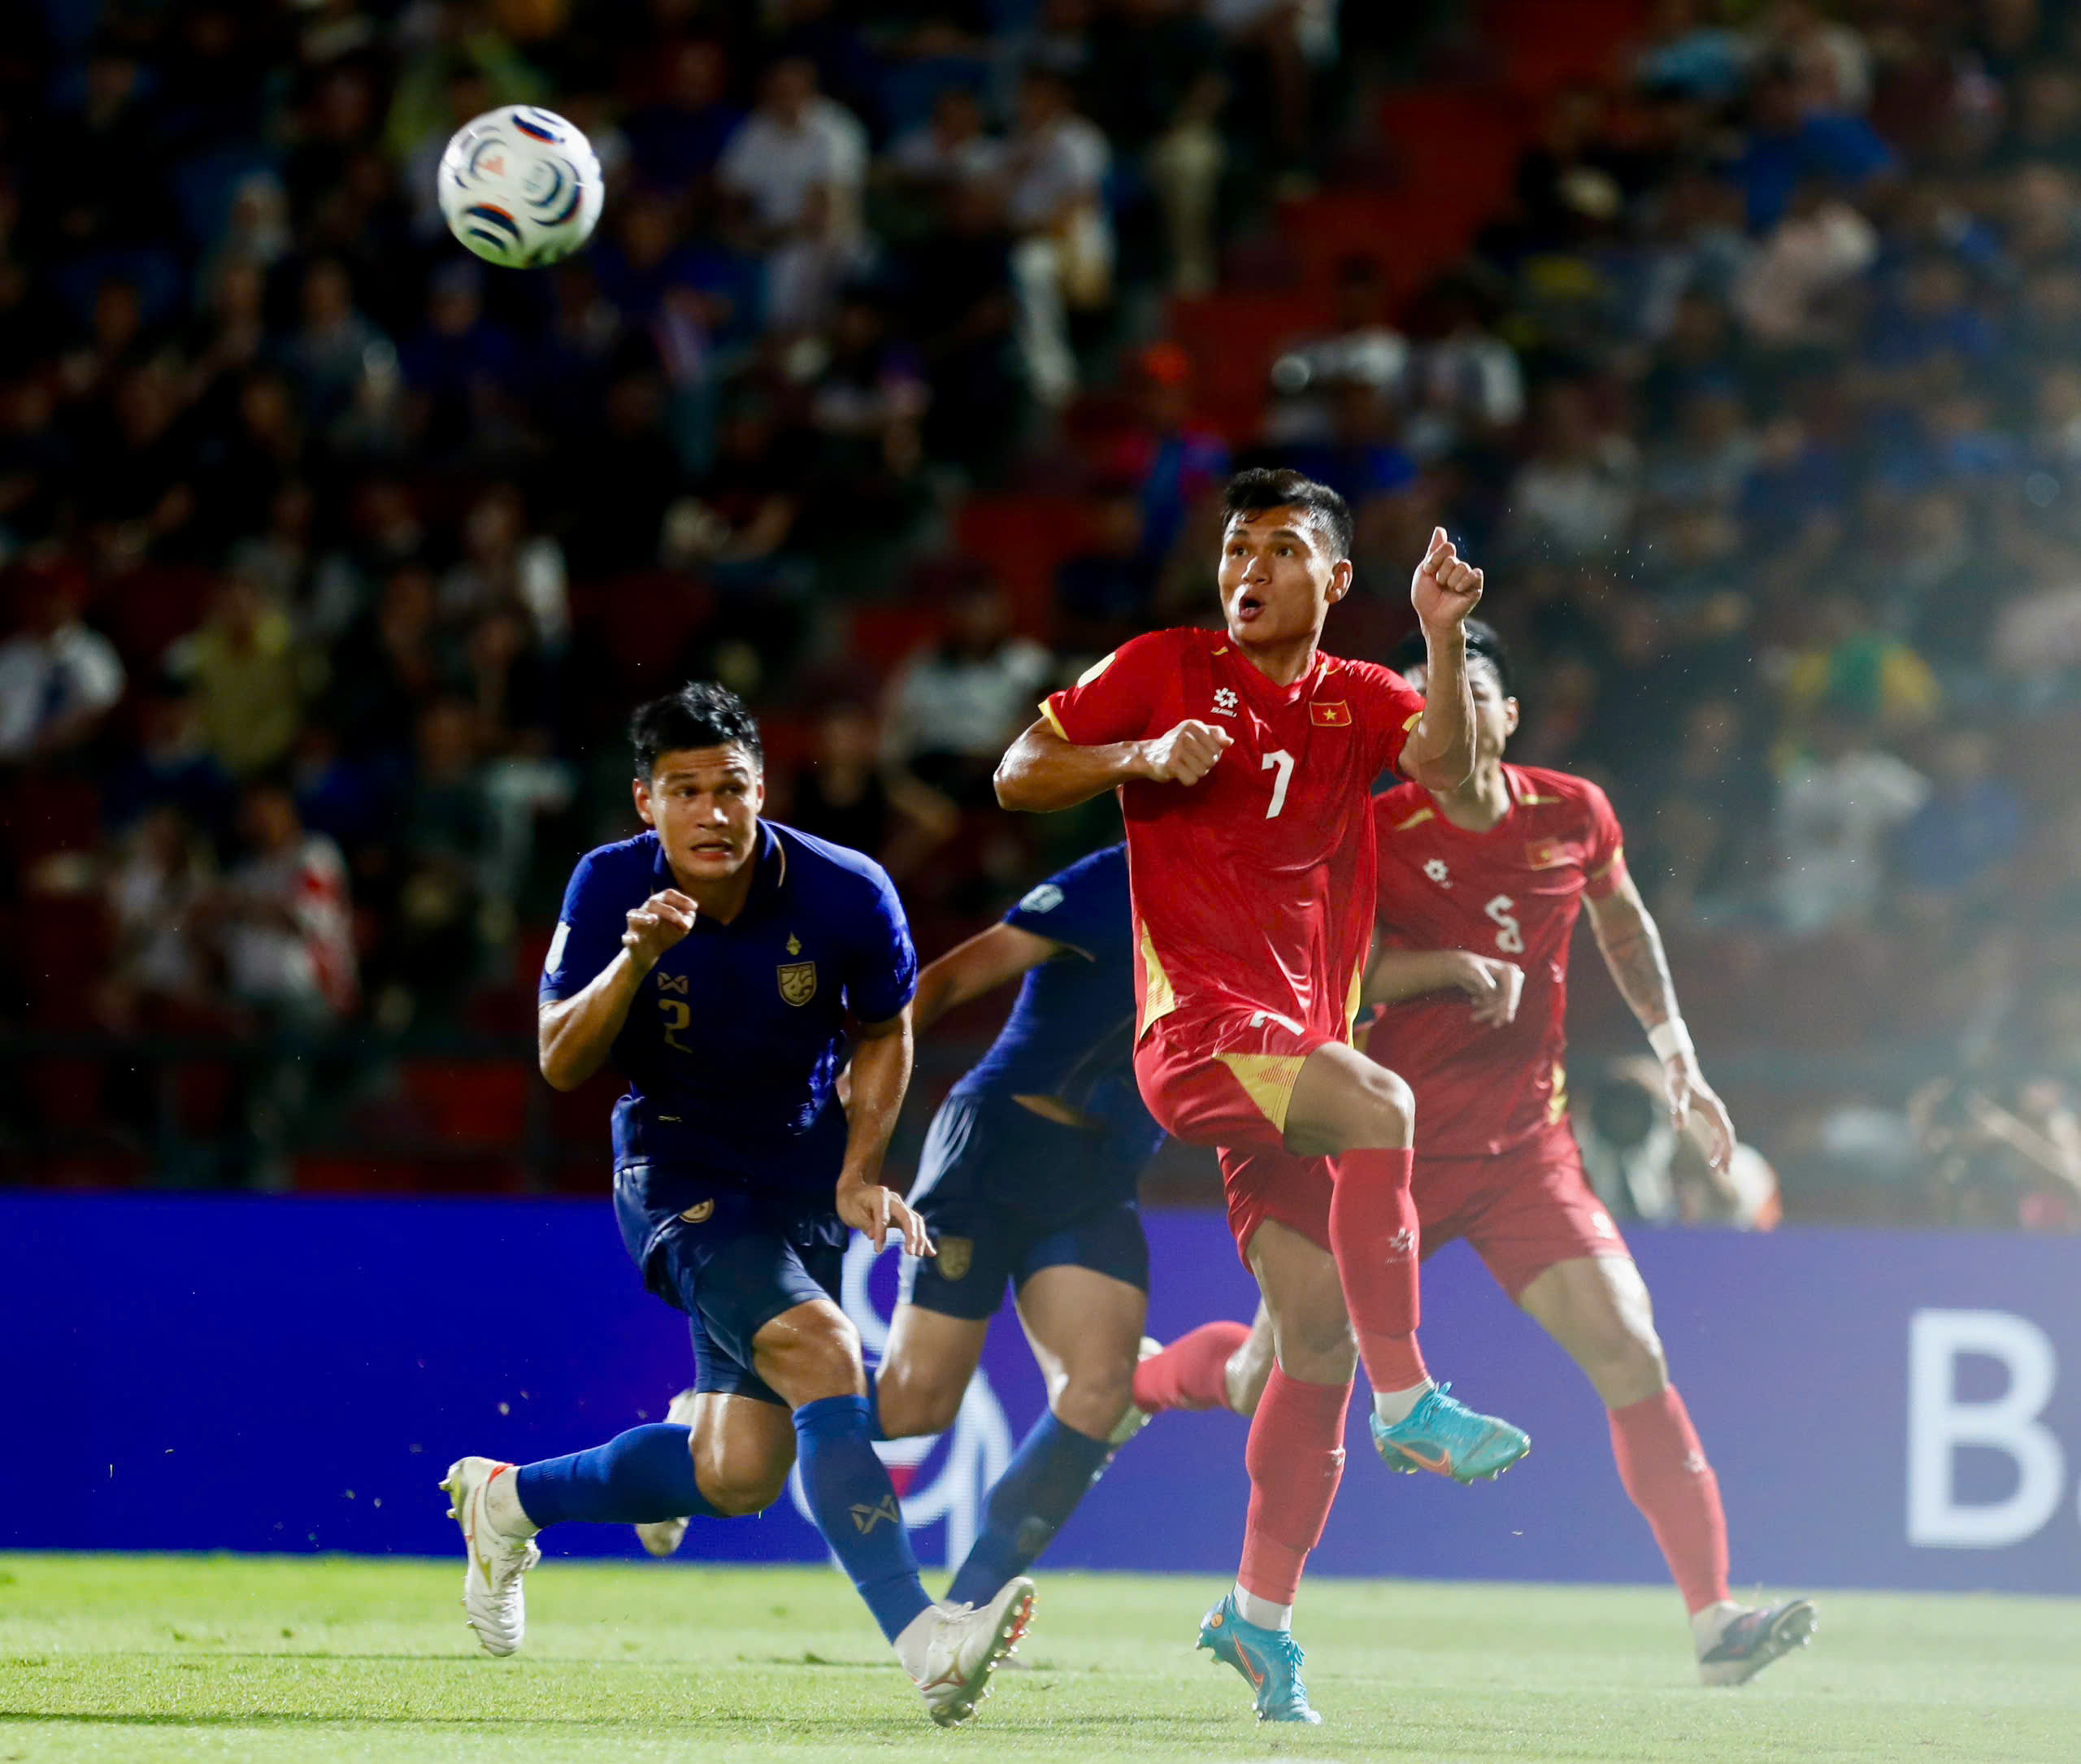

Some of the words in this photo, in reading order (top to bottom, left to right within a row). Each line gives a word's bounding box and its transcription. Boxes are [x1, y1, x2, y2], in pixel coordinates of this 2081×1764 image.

[1262, 749, 1295, 819] 7
[658, 999, 694, 1054] 2
[1906, 1308, 2081, 1548] B
